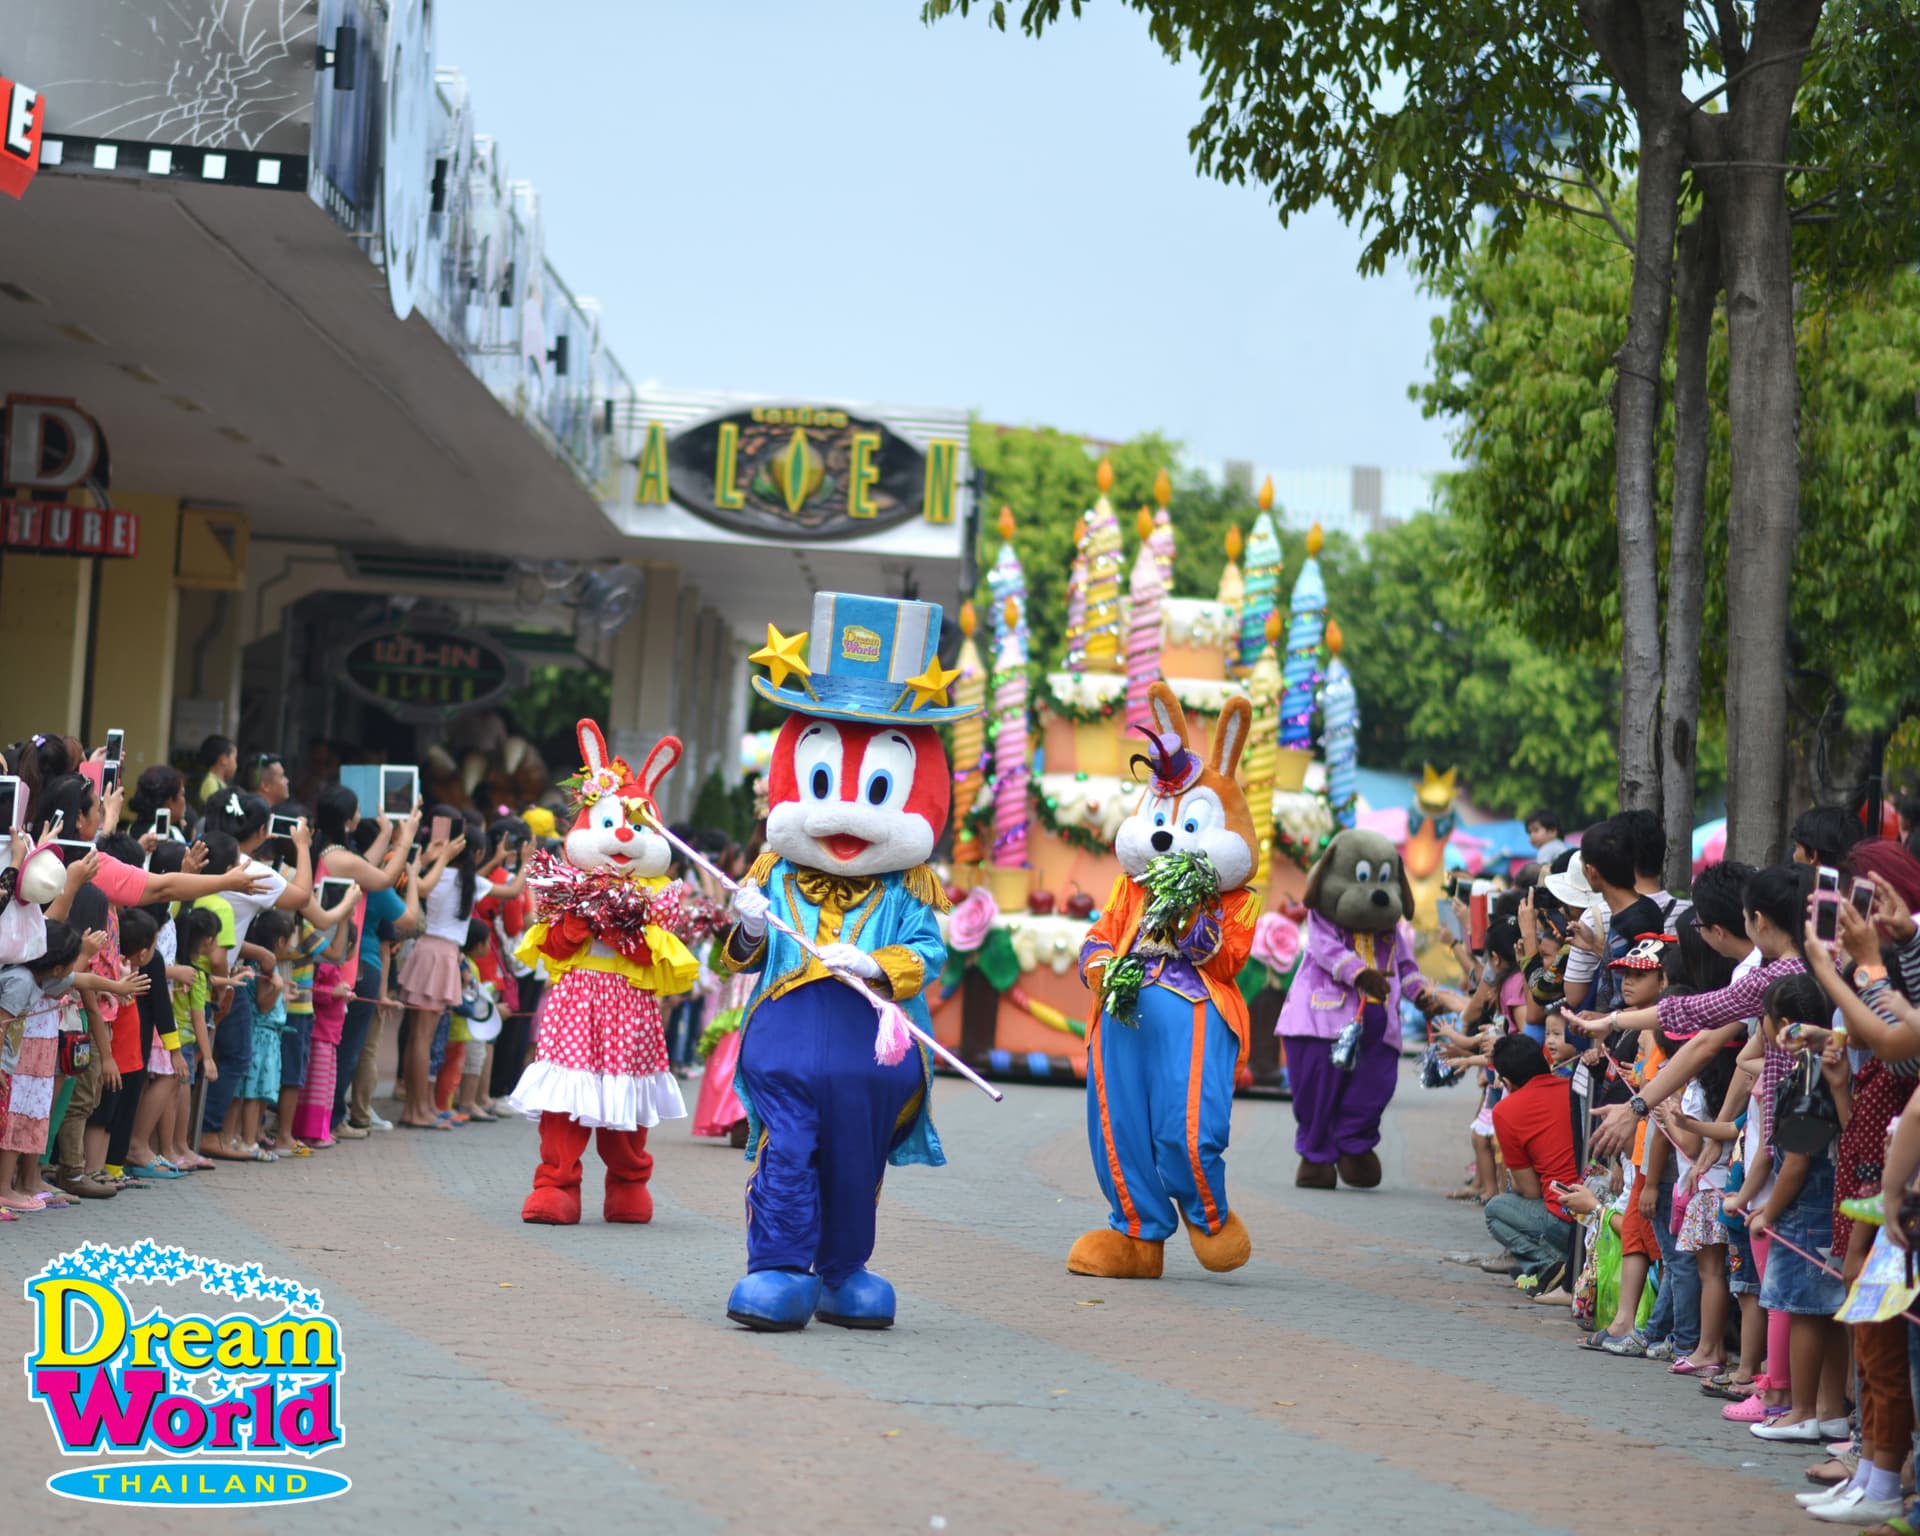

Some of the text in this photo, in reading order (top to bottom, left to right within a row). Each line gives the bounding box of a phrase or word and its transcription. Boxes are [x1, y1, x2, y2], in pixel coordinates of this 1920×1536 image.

[6, 82, 37, 157] E
[635, 420, 958, 523] ALIEN
[0, 504, 128, 550] TURE
[845, 640, 879, 657] World
[846, 629, 880, 647] Dream
